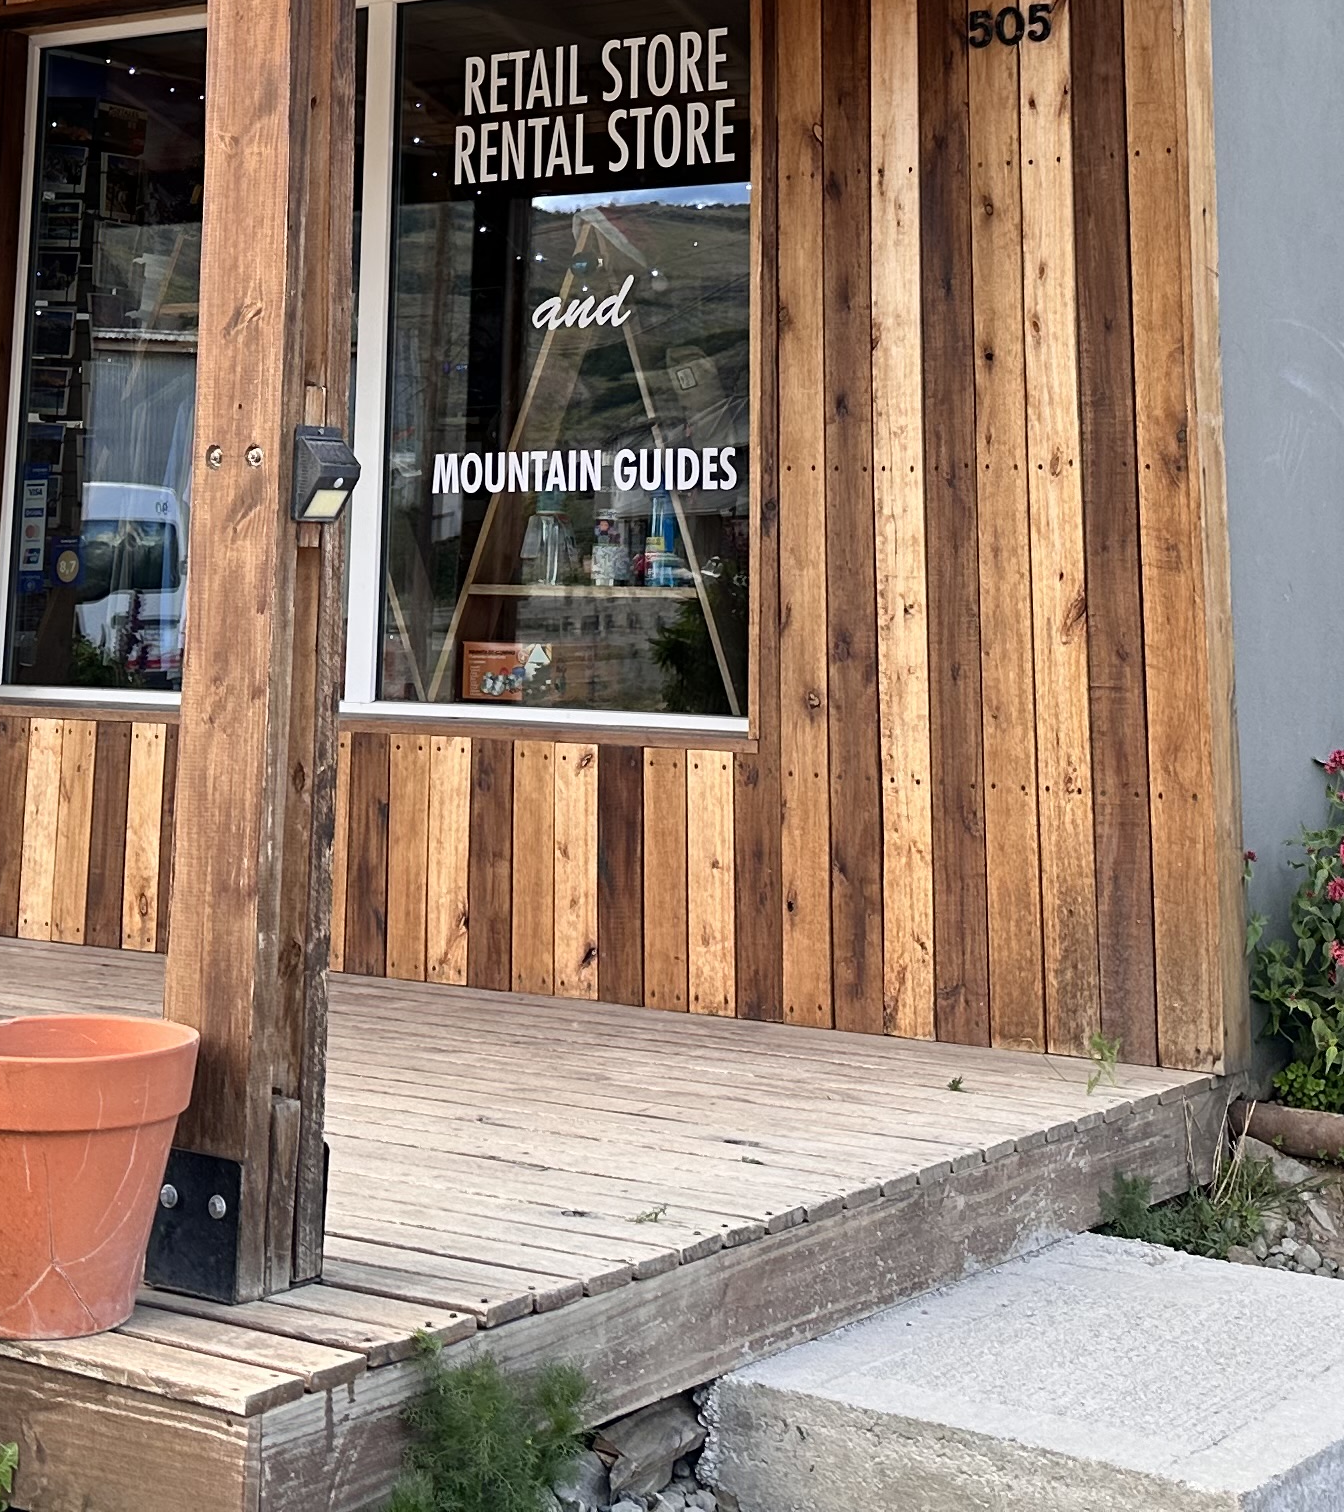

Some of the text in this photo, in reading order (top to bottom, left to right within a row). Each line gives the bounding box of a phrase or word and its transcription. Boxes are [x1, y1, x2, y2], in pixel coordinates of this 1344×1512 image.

[969, 3, 1052, 48] 505
[464, 26, 728, 116] RETAIL STORE
[454, 98, 736, 186] RENTAL STORE
[531, 274, 635, 331] and
[431, 446, 738, 495] MOUNTAIN GUIDES
